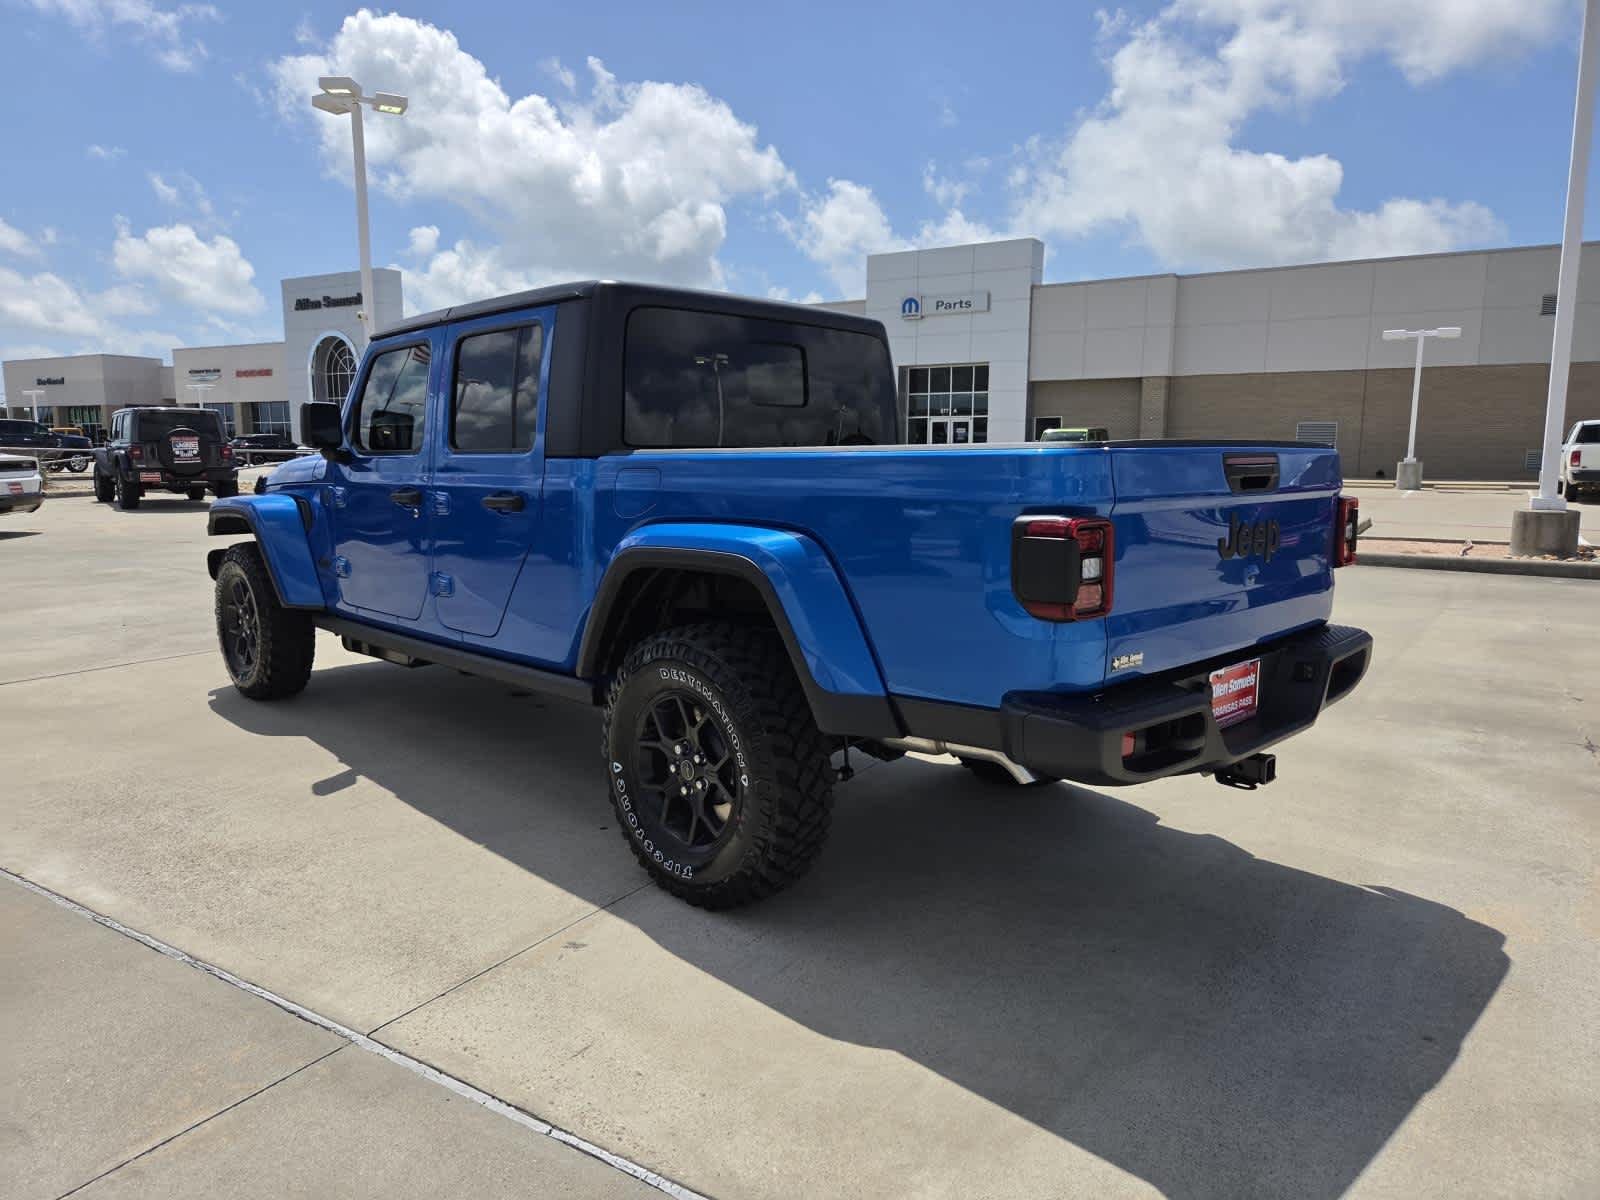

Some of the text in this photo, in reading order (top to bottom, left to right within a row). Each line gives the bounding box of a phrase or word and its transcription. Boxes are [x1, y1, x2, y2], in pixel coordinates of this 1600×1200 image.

[323, 292, 363, 308] Samuel
[935, 299, 972, 311] Parts
[1218, 511, 1281, 564] Jeep
[659, 667, 747, 768] DESTINATION
